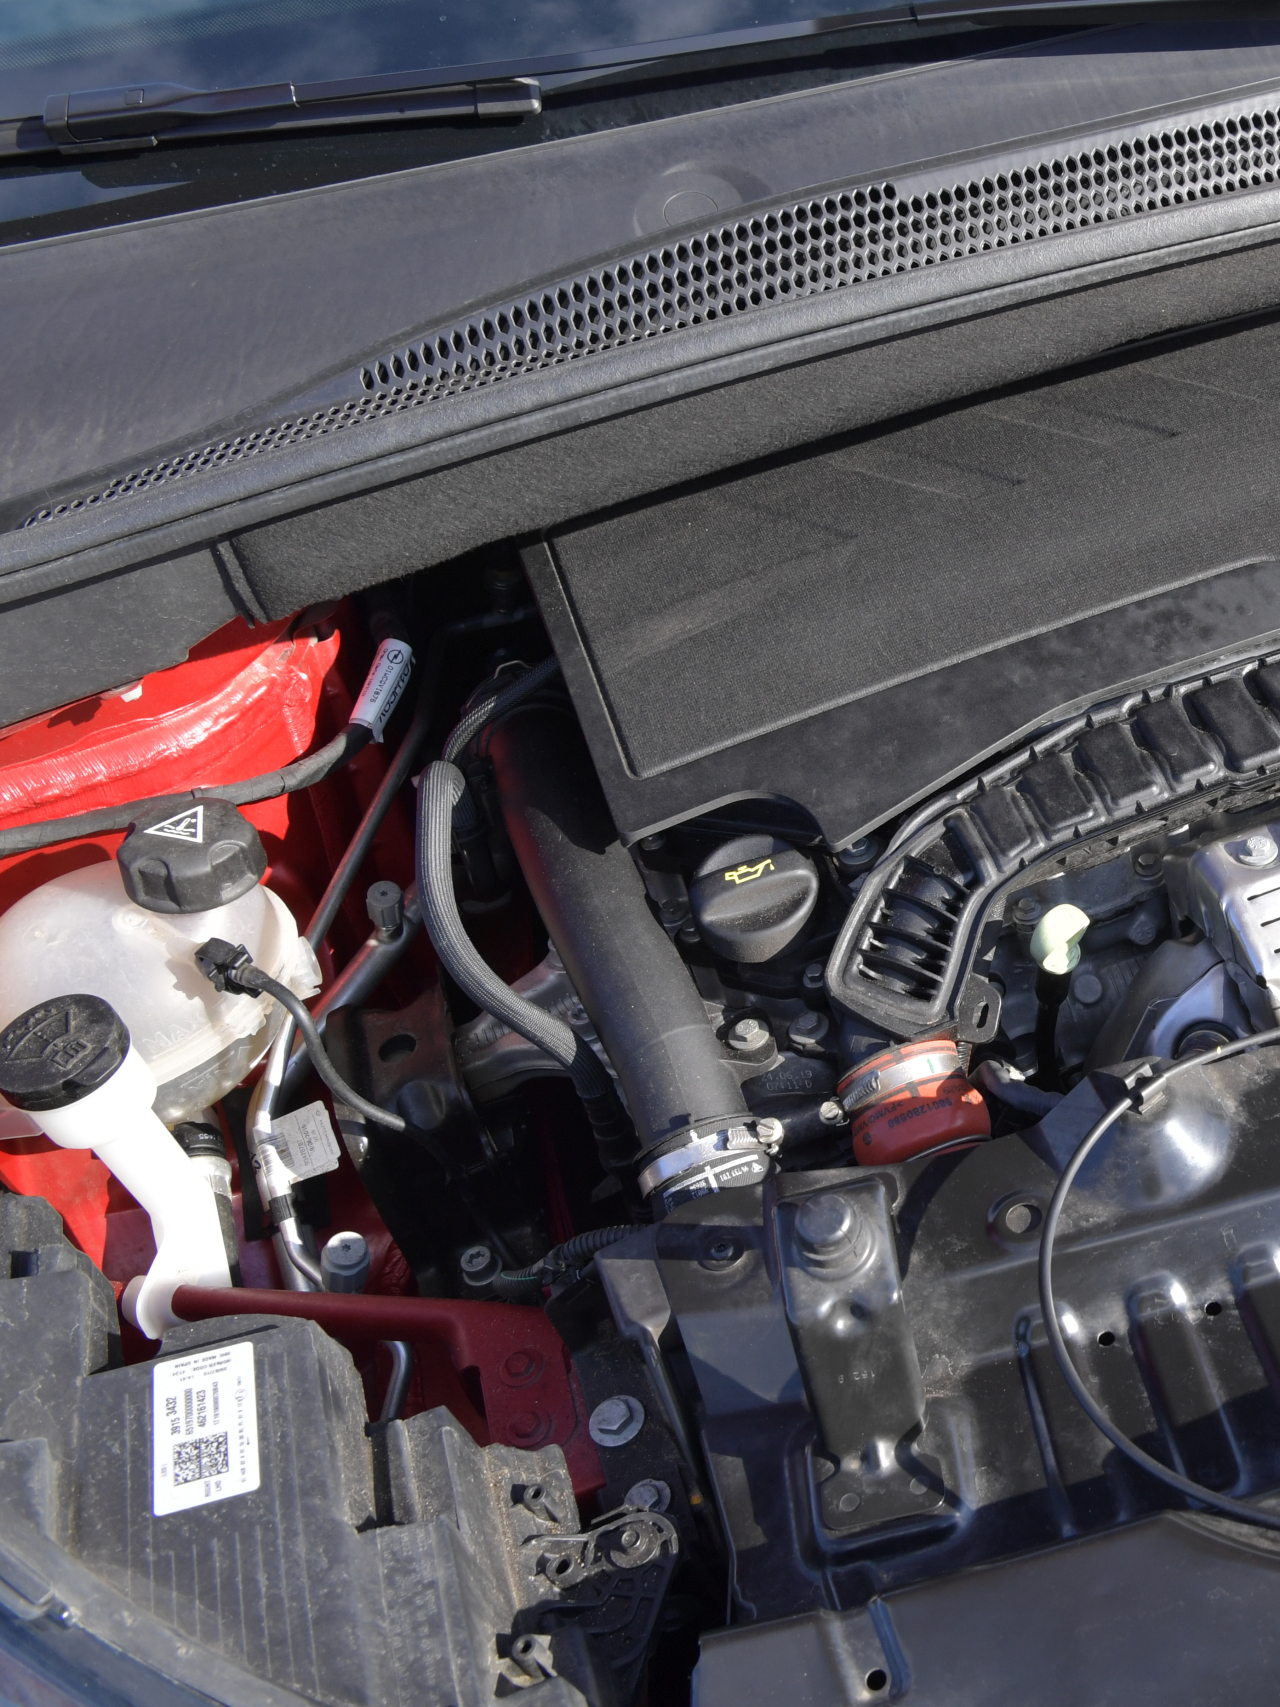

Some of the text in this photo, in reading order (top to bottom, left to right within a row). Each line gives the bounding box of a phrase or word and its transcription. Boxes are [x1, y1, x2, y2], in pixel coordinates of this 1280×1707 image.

[165, 1395, 180, 1435] 3915 3432
[195, 1388, 206, 1428] 462161423
